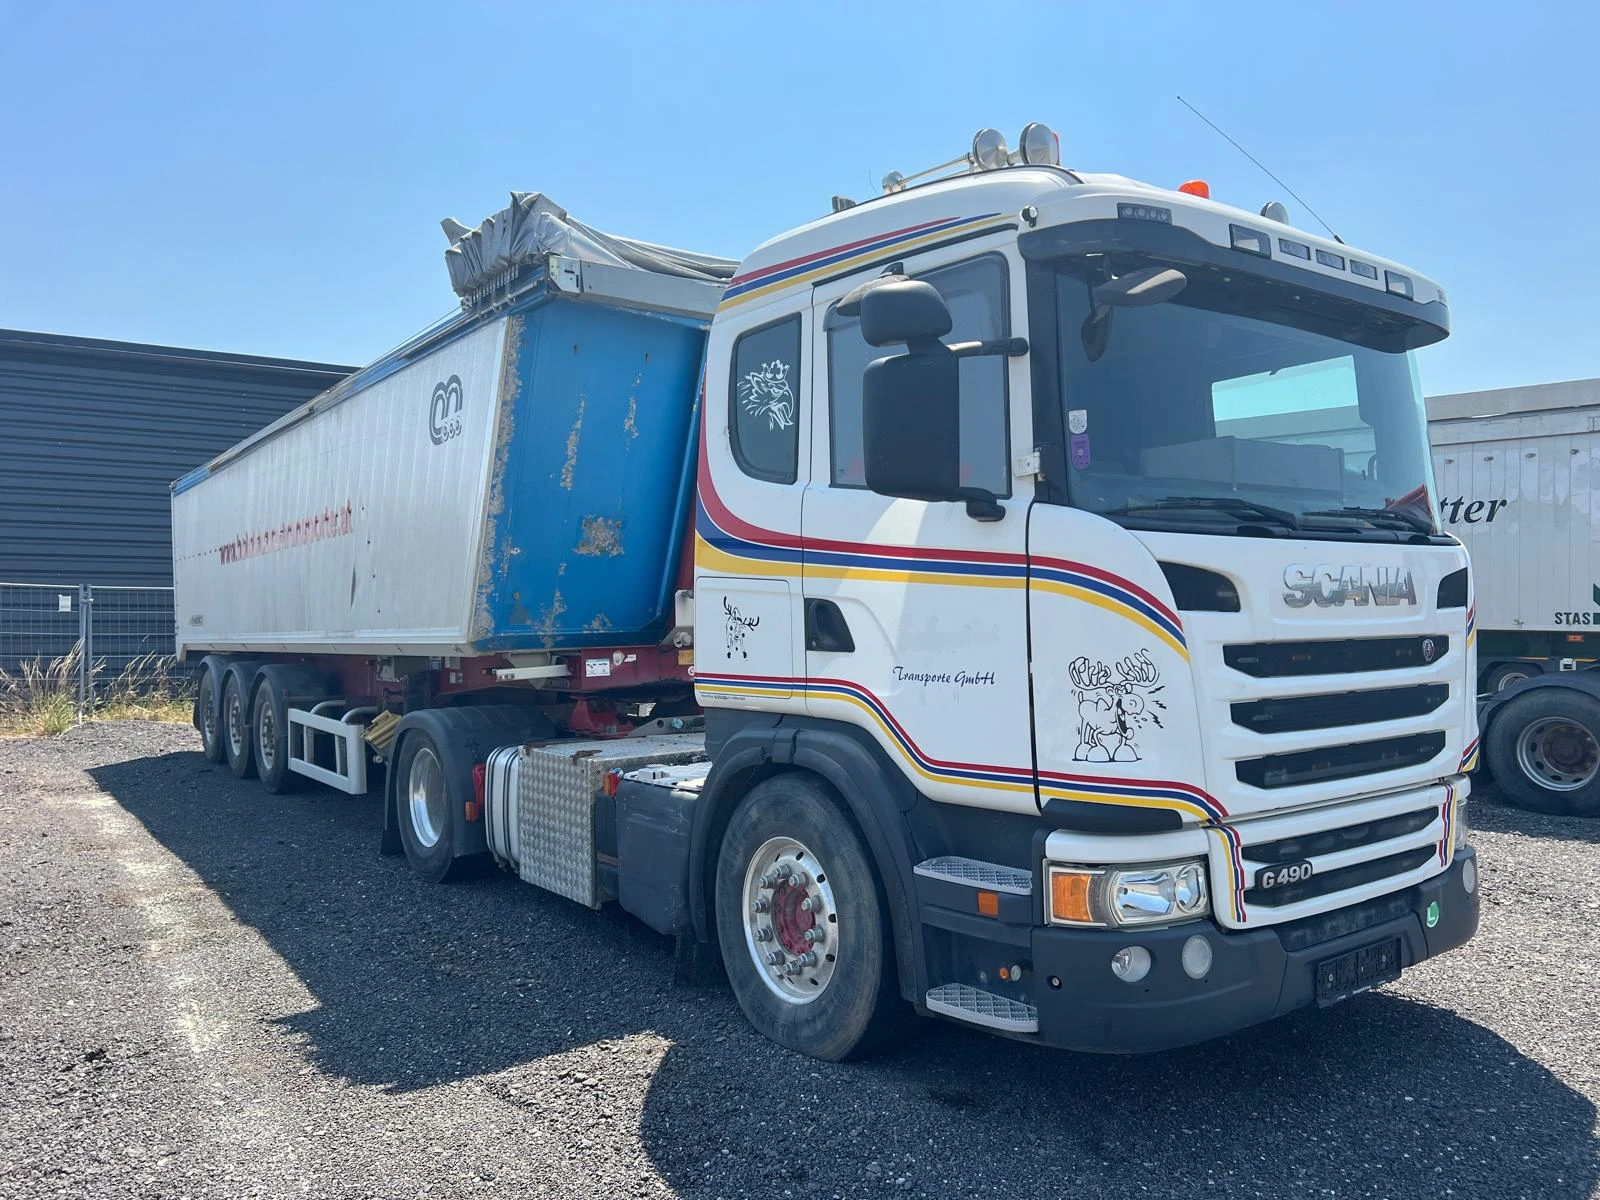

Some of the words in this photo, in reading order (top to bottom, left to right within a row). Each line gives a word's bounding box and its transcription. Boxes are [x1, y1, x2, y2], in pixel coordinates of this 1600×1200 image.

[1283, 563, 1417, 608] SCANIA
[1554, 612, 1591, 625] STAS
[892, 666, 951, 687] Transporte
[954, 670, 995, 687] GmbH
